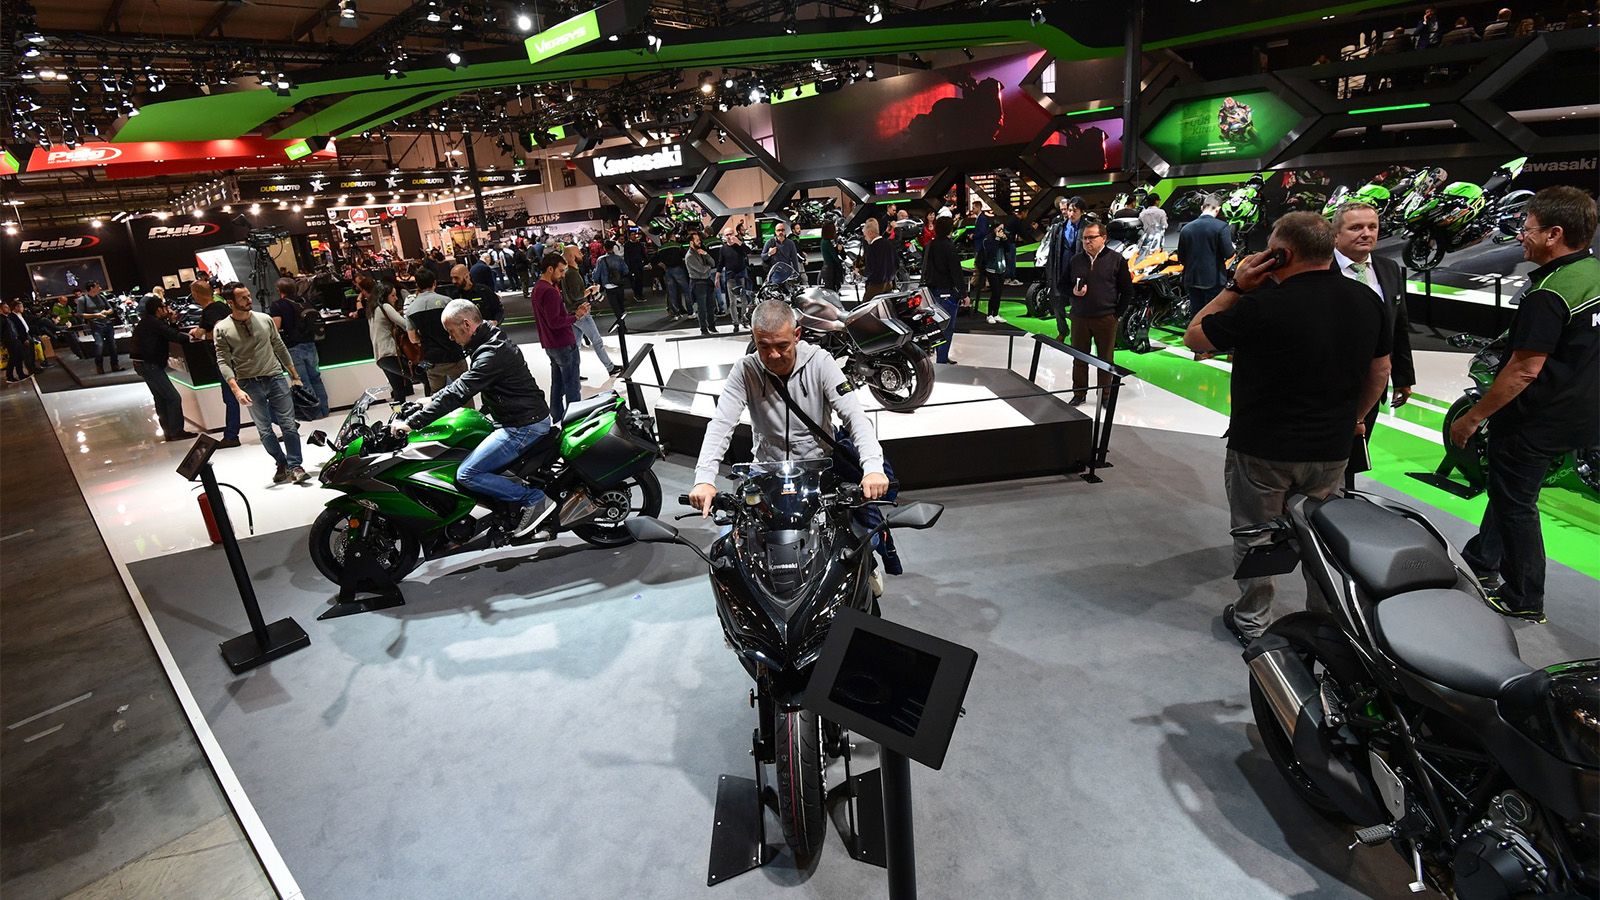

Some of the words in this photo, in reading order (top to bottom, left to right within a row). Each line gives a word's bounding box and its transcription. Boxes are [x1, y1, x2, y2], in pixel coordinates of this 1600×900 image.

[592, 144, 683, 178] Kawasaki
[1523, 157, 1598, 173] awasaki
[148, 224, 206, 236] Puig
[20, 237, 83, 250] Puig
[768, 562, 798, 571] Kawasaki
